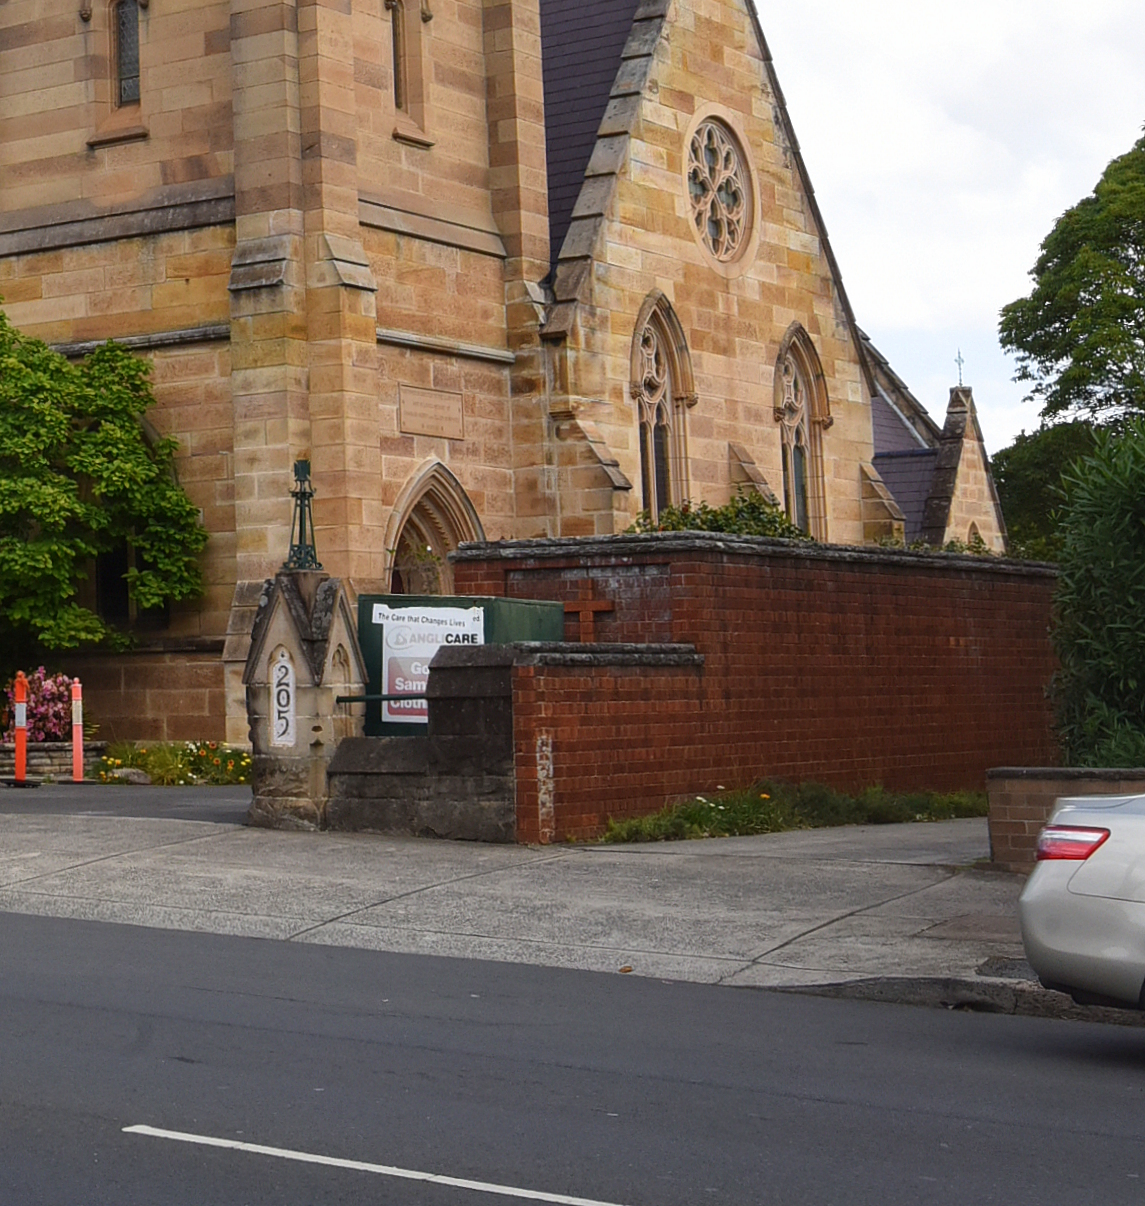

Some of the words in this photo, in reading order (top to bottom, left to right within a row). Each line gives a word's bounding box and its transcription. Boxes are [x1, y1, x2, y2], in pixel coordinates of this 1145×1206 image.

[378, 612, 389, 621] The
[391, 614, 405, 622] Care
[407, 615, 420, 623] that
[421, 616, 448, 626] Changes
[449, 619, 465, 627] Lives
[276, 665, 290, 738] 205
